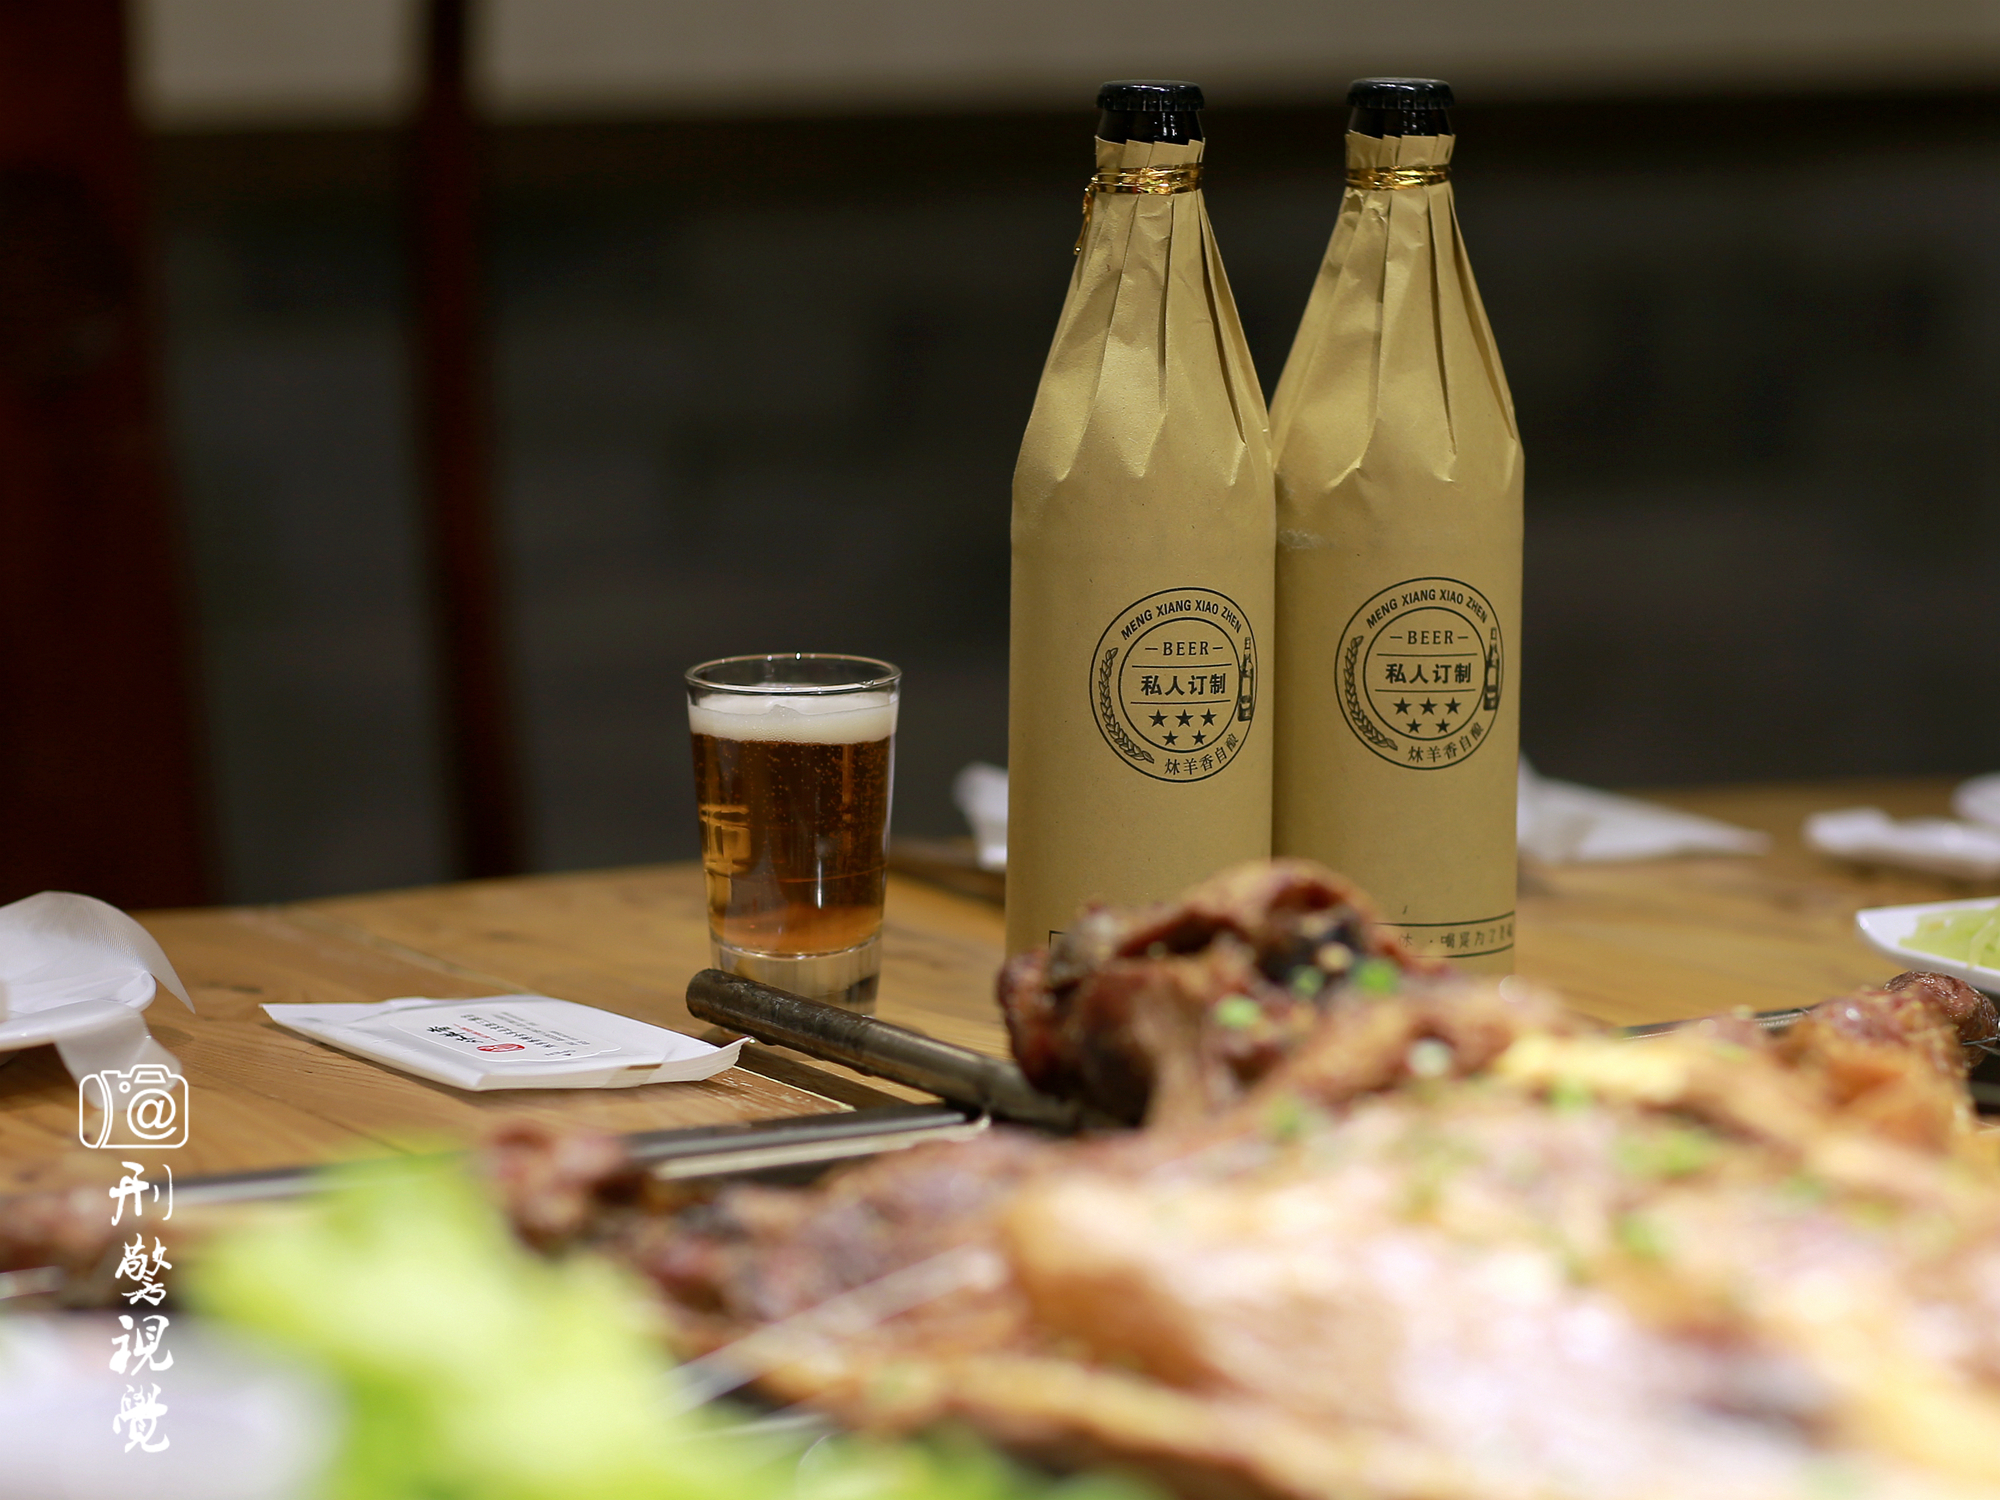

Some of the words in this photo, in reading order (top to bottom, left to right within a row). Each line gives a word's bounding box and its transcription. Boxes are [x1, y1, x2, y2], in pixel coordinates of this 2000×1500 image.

[1120, 609, 1153, 640] MENG
[1156, 600, 1192, 618] XIANG
[1195, 599, 1219, 615] XIAO
[1221, 606, 1242, 634] ZHEN
[1366, 598, 1399, 629] MENG
[1402, 589, 1436, 607] XIANG
[1440, 589, 1464, 605] XIAO
[1466, 596, 1488, 624] ZHEN
[1163, 641, 1210, 656] BEER
[1408, 630, 1454, 645] BEER
[1385, 662, 1472, 684] 私人订制
[1141, 673, 1227, 696] 私人订制
